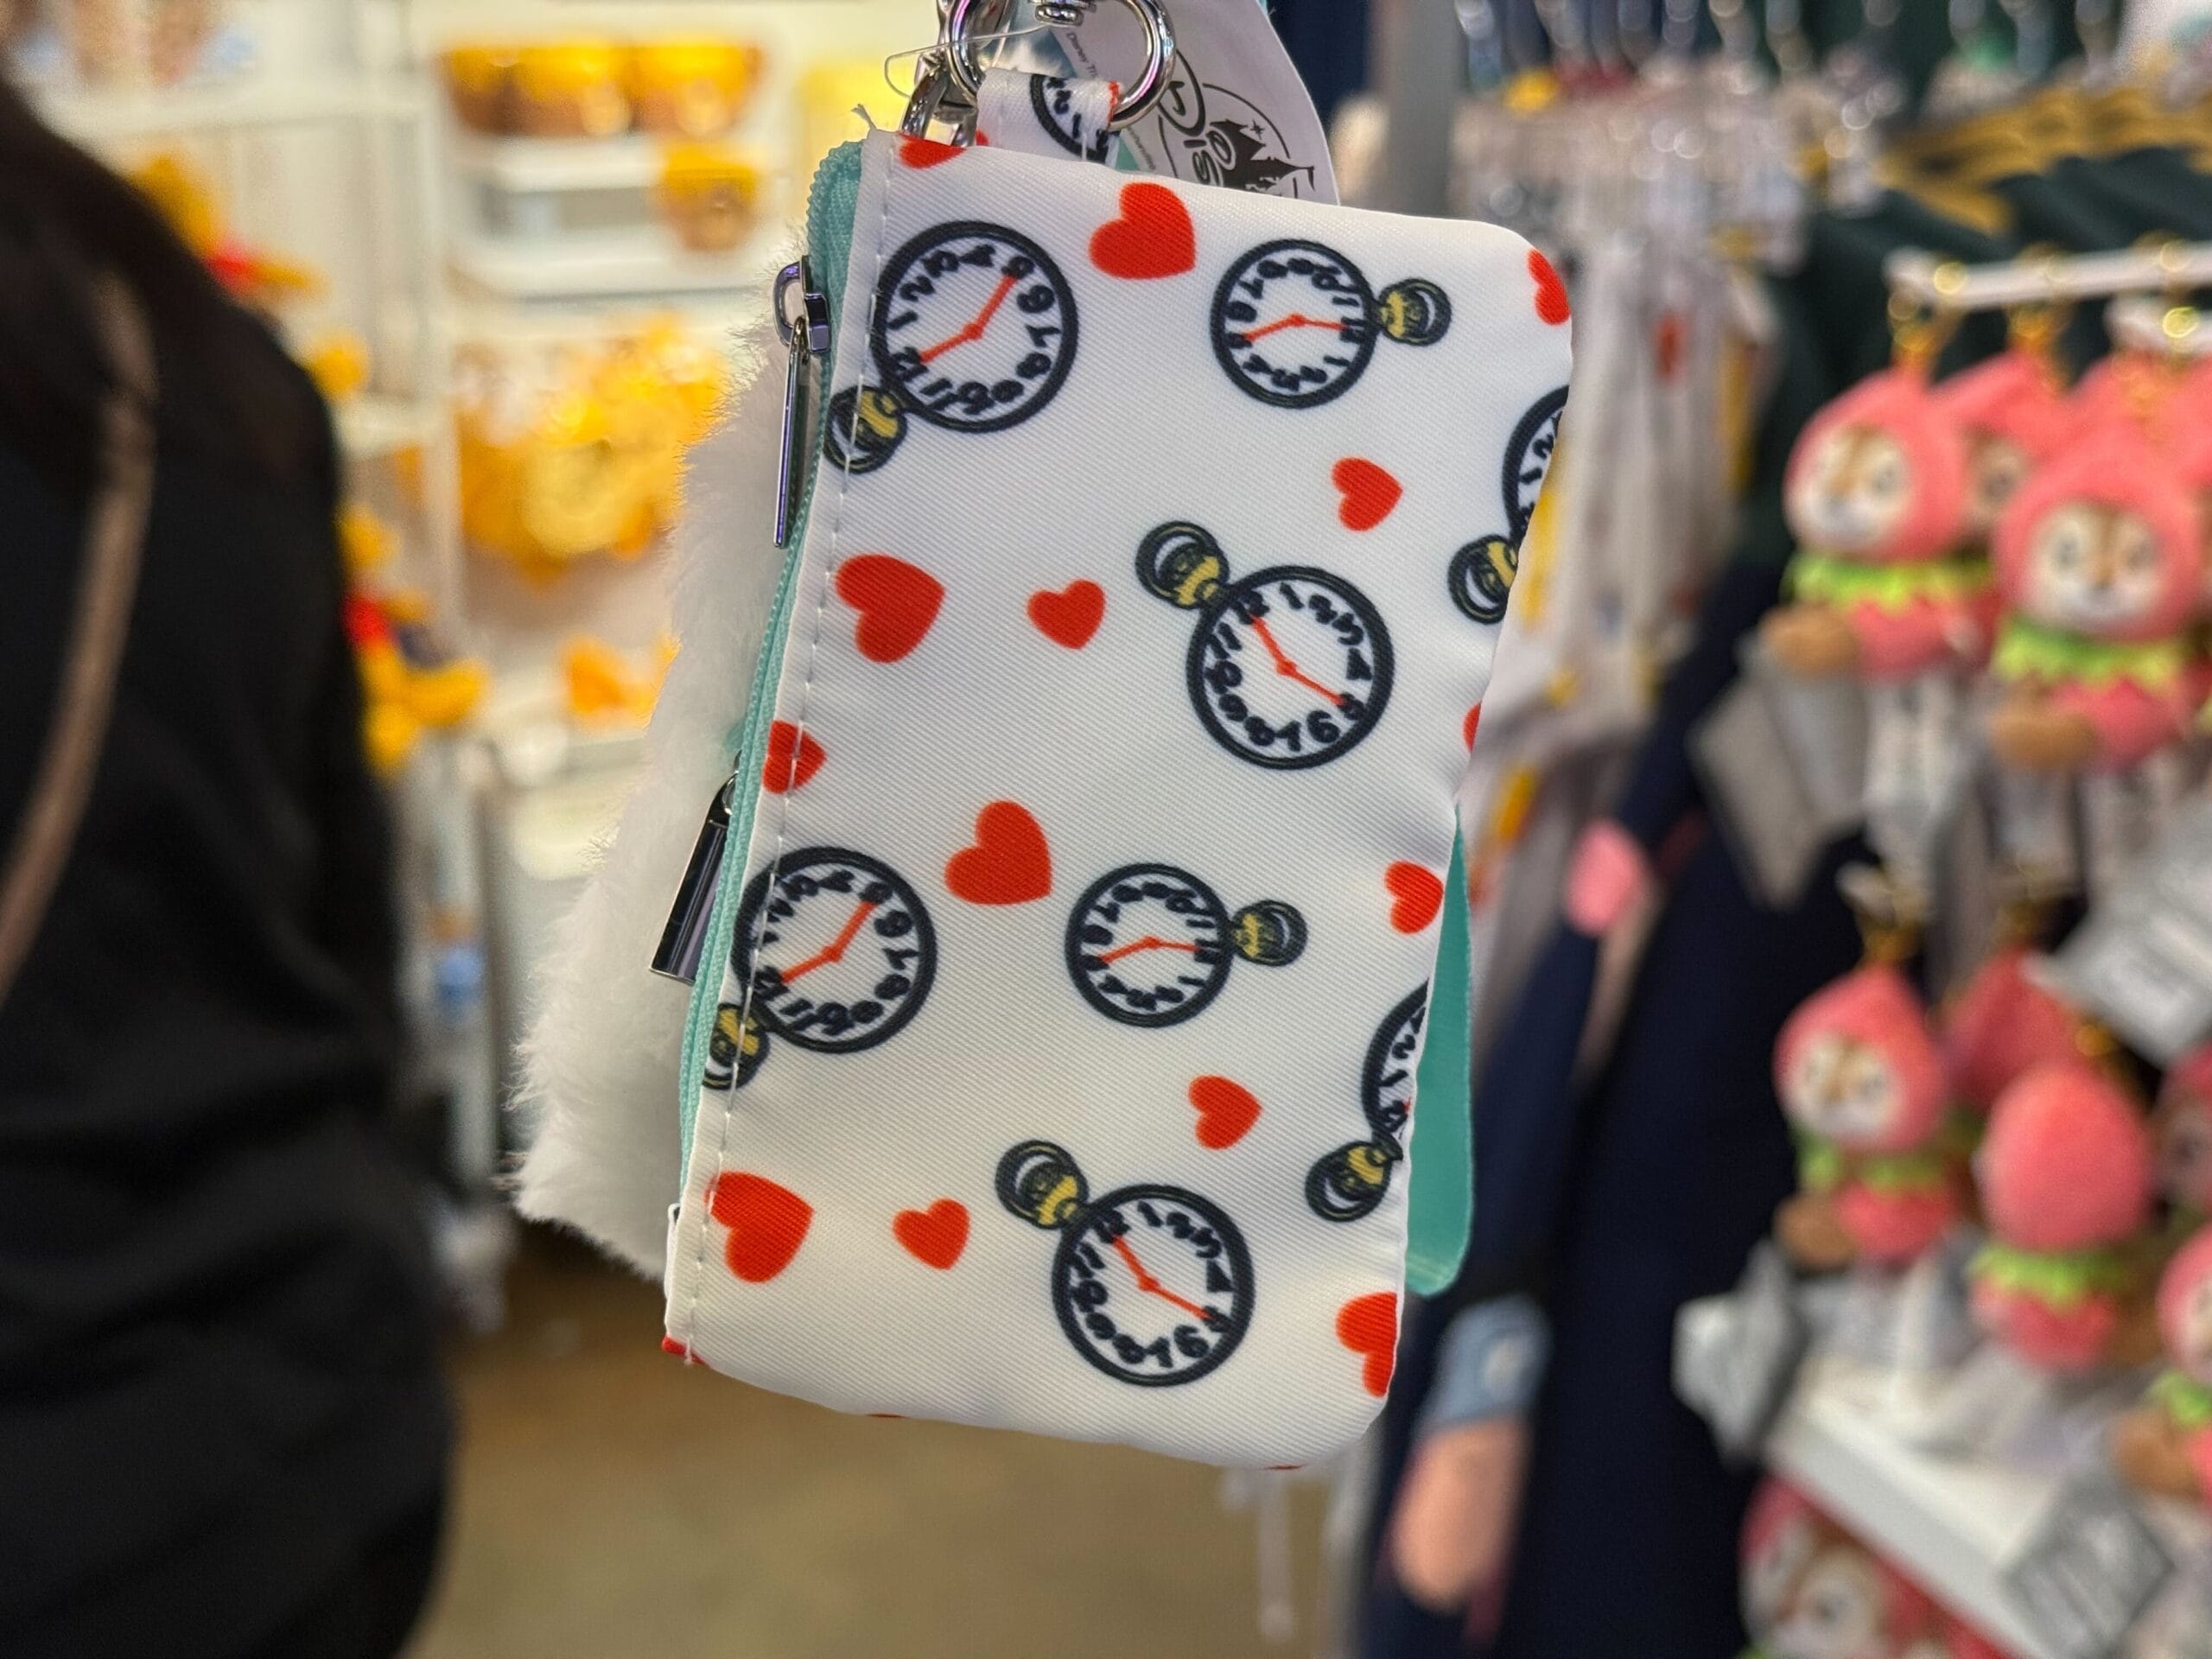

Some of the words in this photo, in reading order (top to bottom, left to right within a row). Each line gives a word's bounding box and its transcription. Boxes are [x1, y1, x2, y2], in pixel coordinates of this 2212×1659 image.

[899, 275, 935, 302] 2
[1017, 285, 1055, 314] 6
[1280, 582, 1305, 610] 1
[1210, 622, 1242, 659] 11
[1332, 613, 1363, 645] 3
[1346, 648, 1373, 681] 4
[1244, 715, 1275, 747] 8
[1276, 721, 1301, 752] 7
[1306, 710, 1339, 743] 6
[1137, 1200, 1164, 1228] 1
[1190, 1226, 1221, 1258] 3
[1206, 1259, 1234, 1293] 4
[1173, 1325, 1210, 1357] 6
